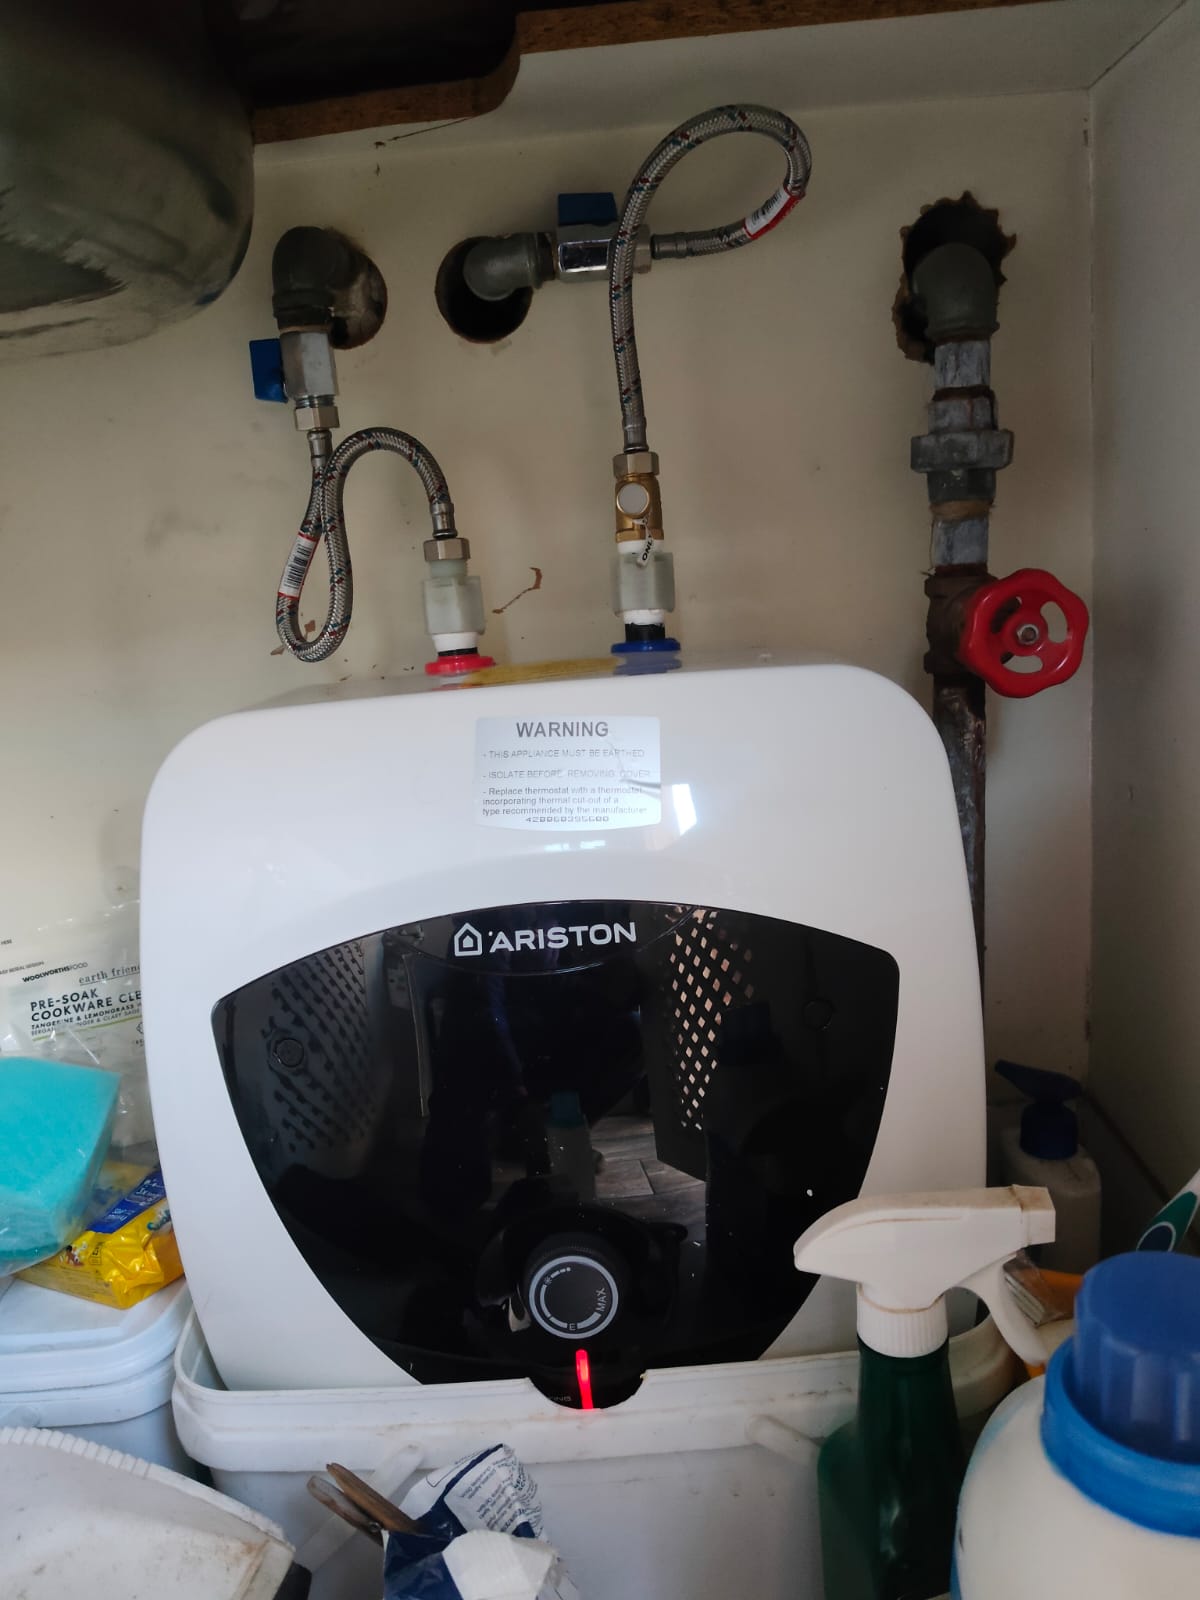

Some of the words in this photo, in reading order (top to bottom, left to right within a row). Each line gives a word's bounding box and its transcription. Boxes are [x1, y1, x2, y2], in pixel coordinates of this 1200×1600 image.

[516, 721, 609, 738] WARNING
[488, 750, 509, 759] THIS
[511, 749, 560, 758] APPLIANCE
[562, 749, 586, 757] MUST
[589, 749, 600, 757] BE
[603, 749, 645, 757] EARTHED
[488, 770, 526, 779] ISOLATE
[527, 769, 562, 778] BEFORE
[567, 769, 615, 777] REMOVING
[620, 769, 650, 778] COVER
[488, 787, 523, 797] Replace
[525, 786, 569, 795] thermostat
[571, 786, 588, 794] with
[482, 797, 537, 806] incorporating
[539, 796, 570, 805] thermal
[603, 796, 612, 804] of
[482, 808, 500, 816] type
[502, 806, 562, 815] recommended
[564, 806, 574, 815] by
[577, 806, 590, 814] the
[488, 922, 637, 953] ARISTON
[78, 969, 108, 984] earth
[30, 987, 99, 1011] PRE-SOAK
[31, 996, 113, 1021] COOKWARE
[118, 990, 142, 1003] CLE
[84, 1003, 134, 1020] LEMONGRASS
[595, 1287, 607, 1312] MAX
[569, 1323, 577, 1331] E
